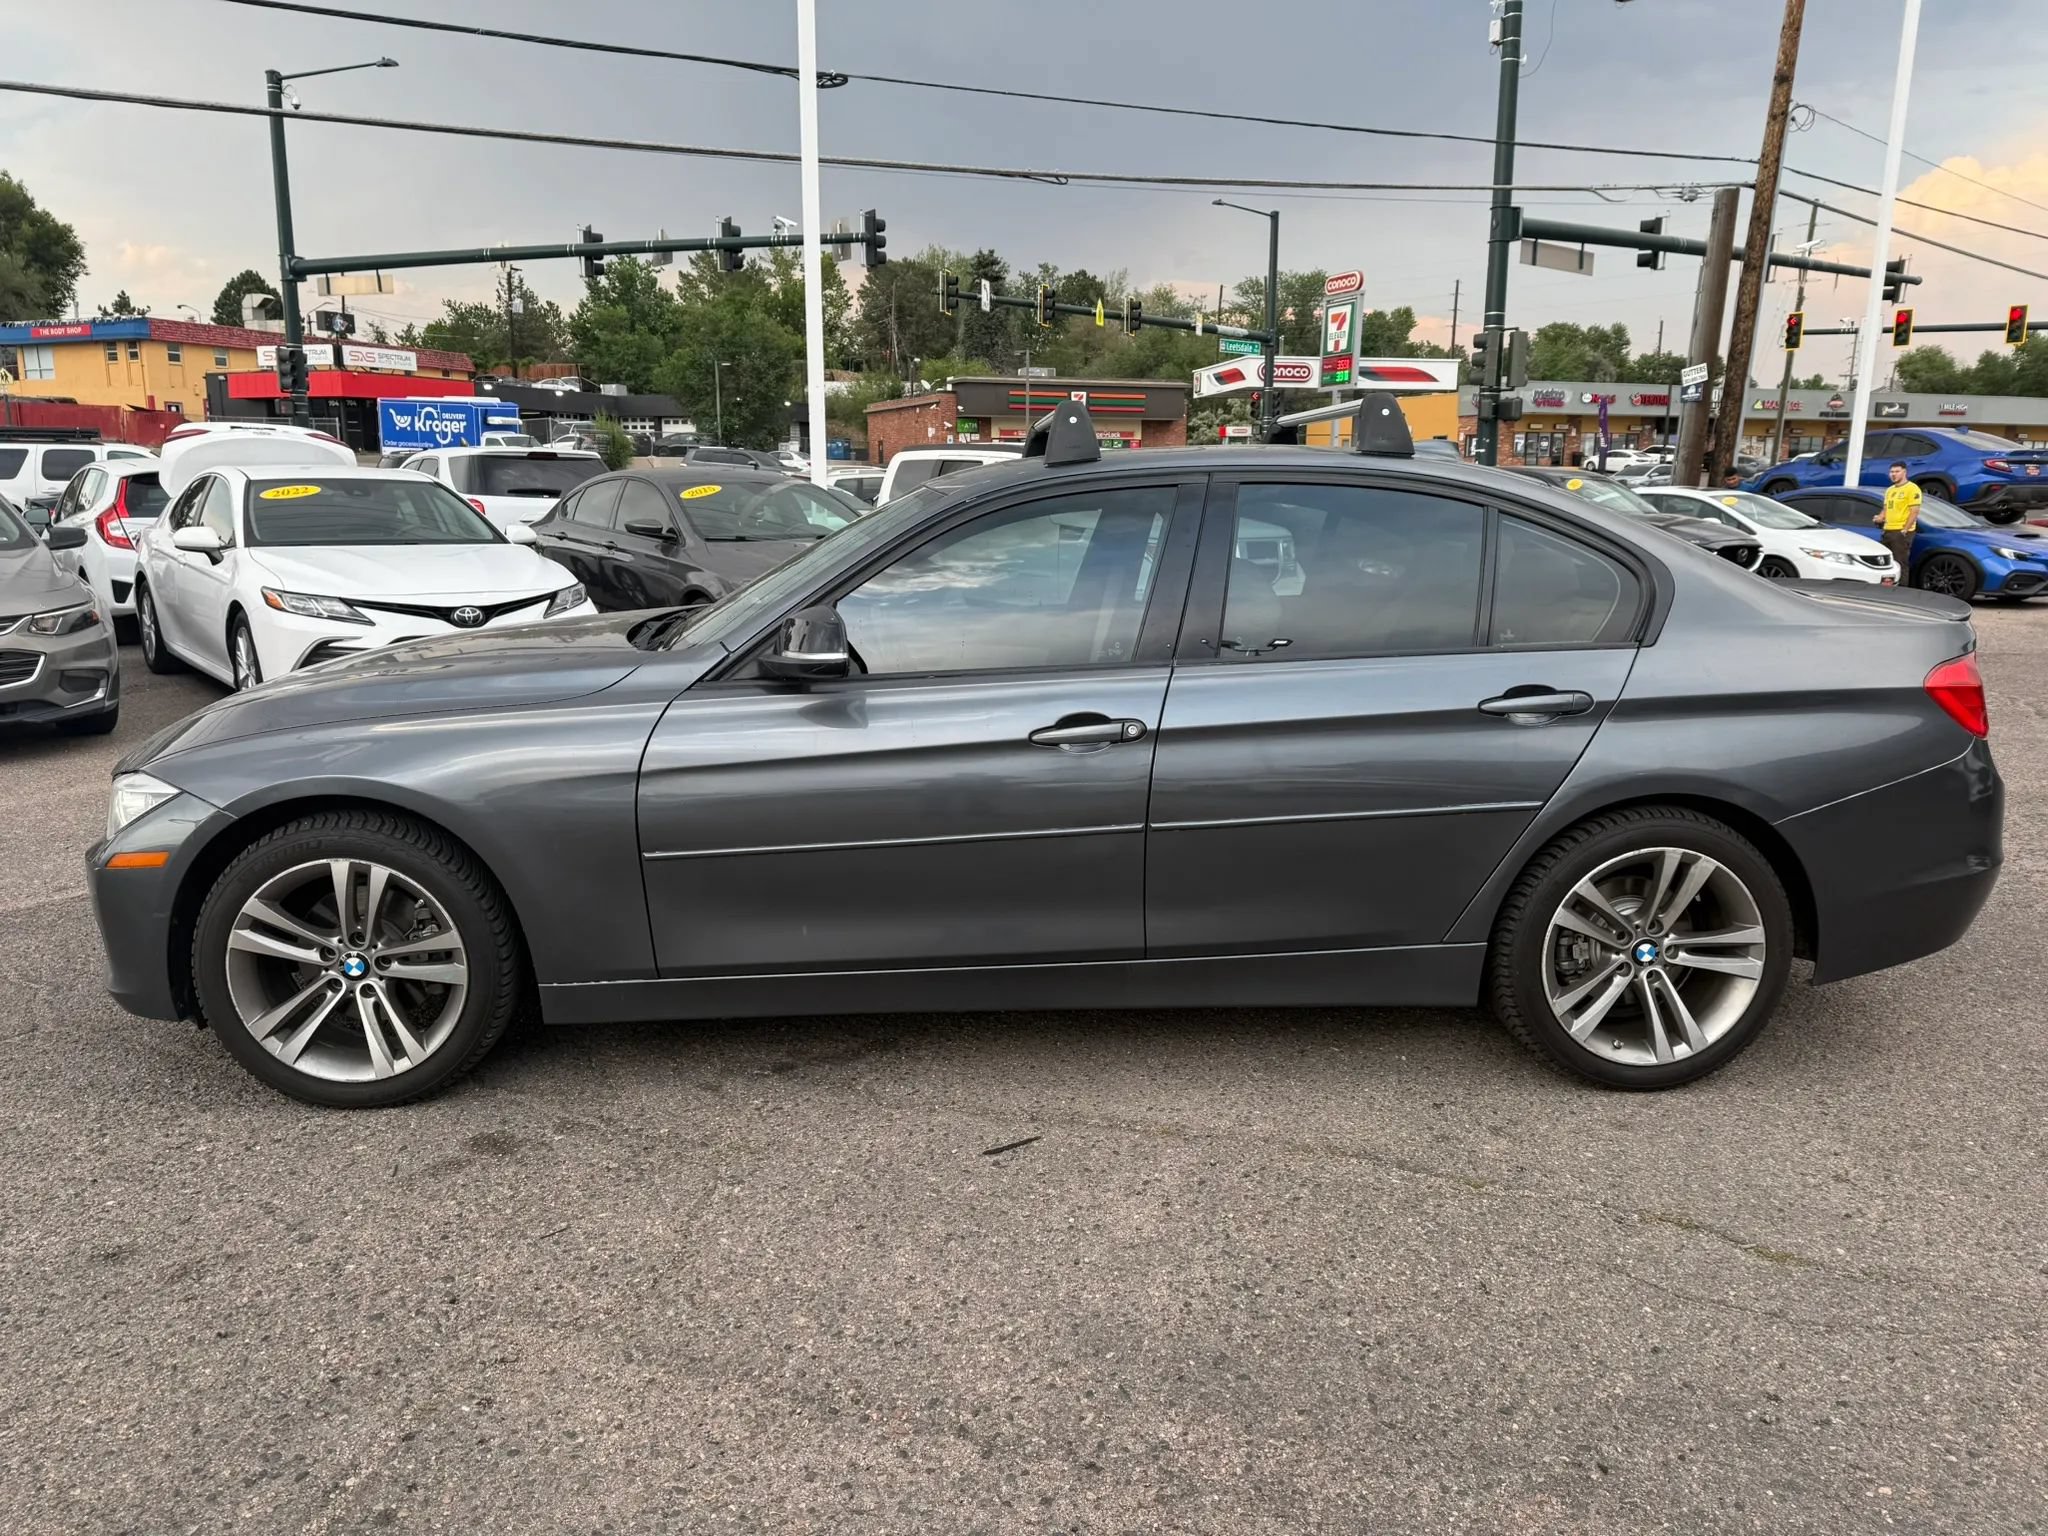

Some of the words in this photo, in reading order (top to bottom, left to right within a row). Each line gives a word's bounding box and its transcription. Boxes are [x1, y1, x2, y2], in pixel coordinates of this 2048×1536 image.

[39, 328, 49, 336] THE
[50, 327, 65, 335] BODY
[66, 326, 82, 334] SHOP
[1226, 341, 1252, 353] Leetsdale
[377, 352, 411, 362] SPECTRUM
[414, 406, 467, 445] Kroger
